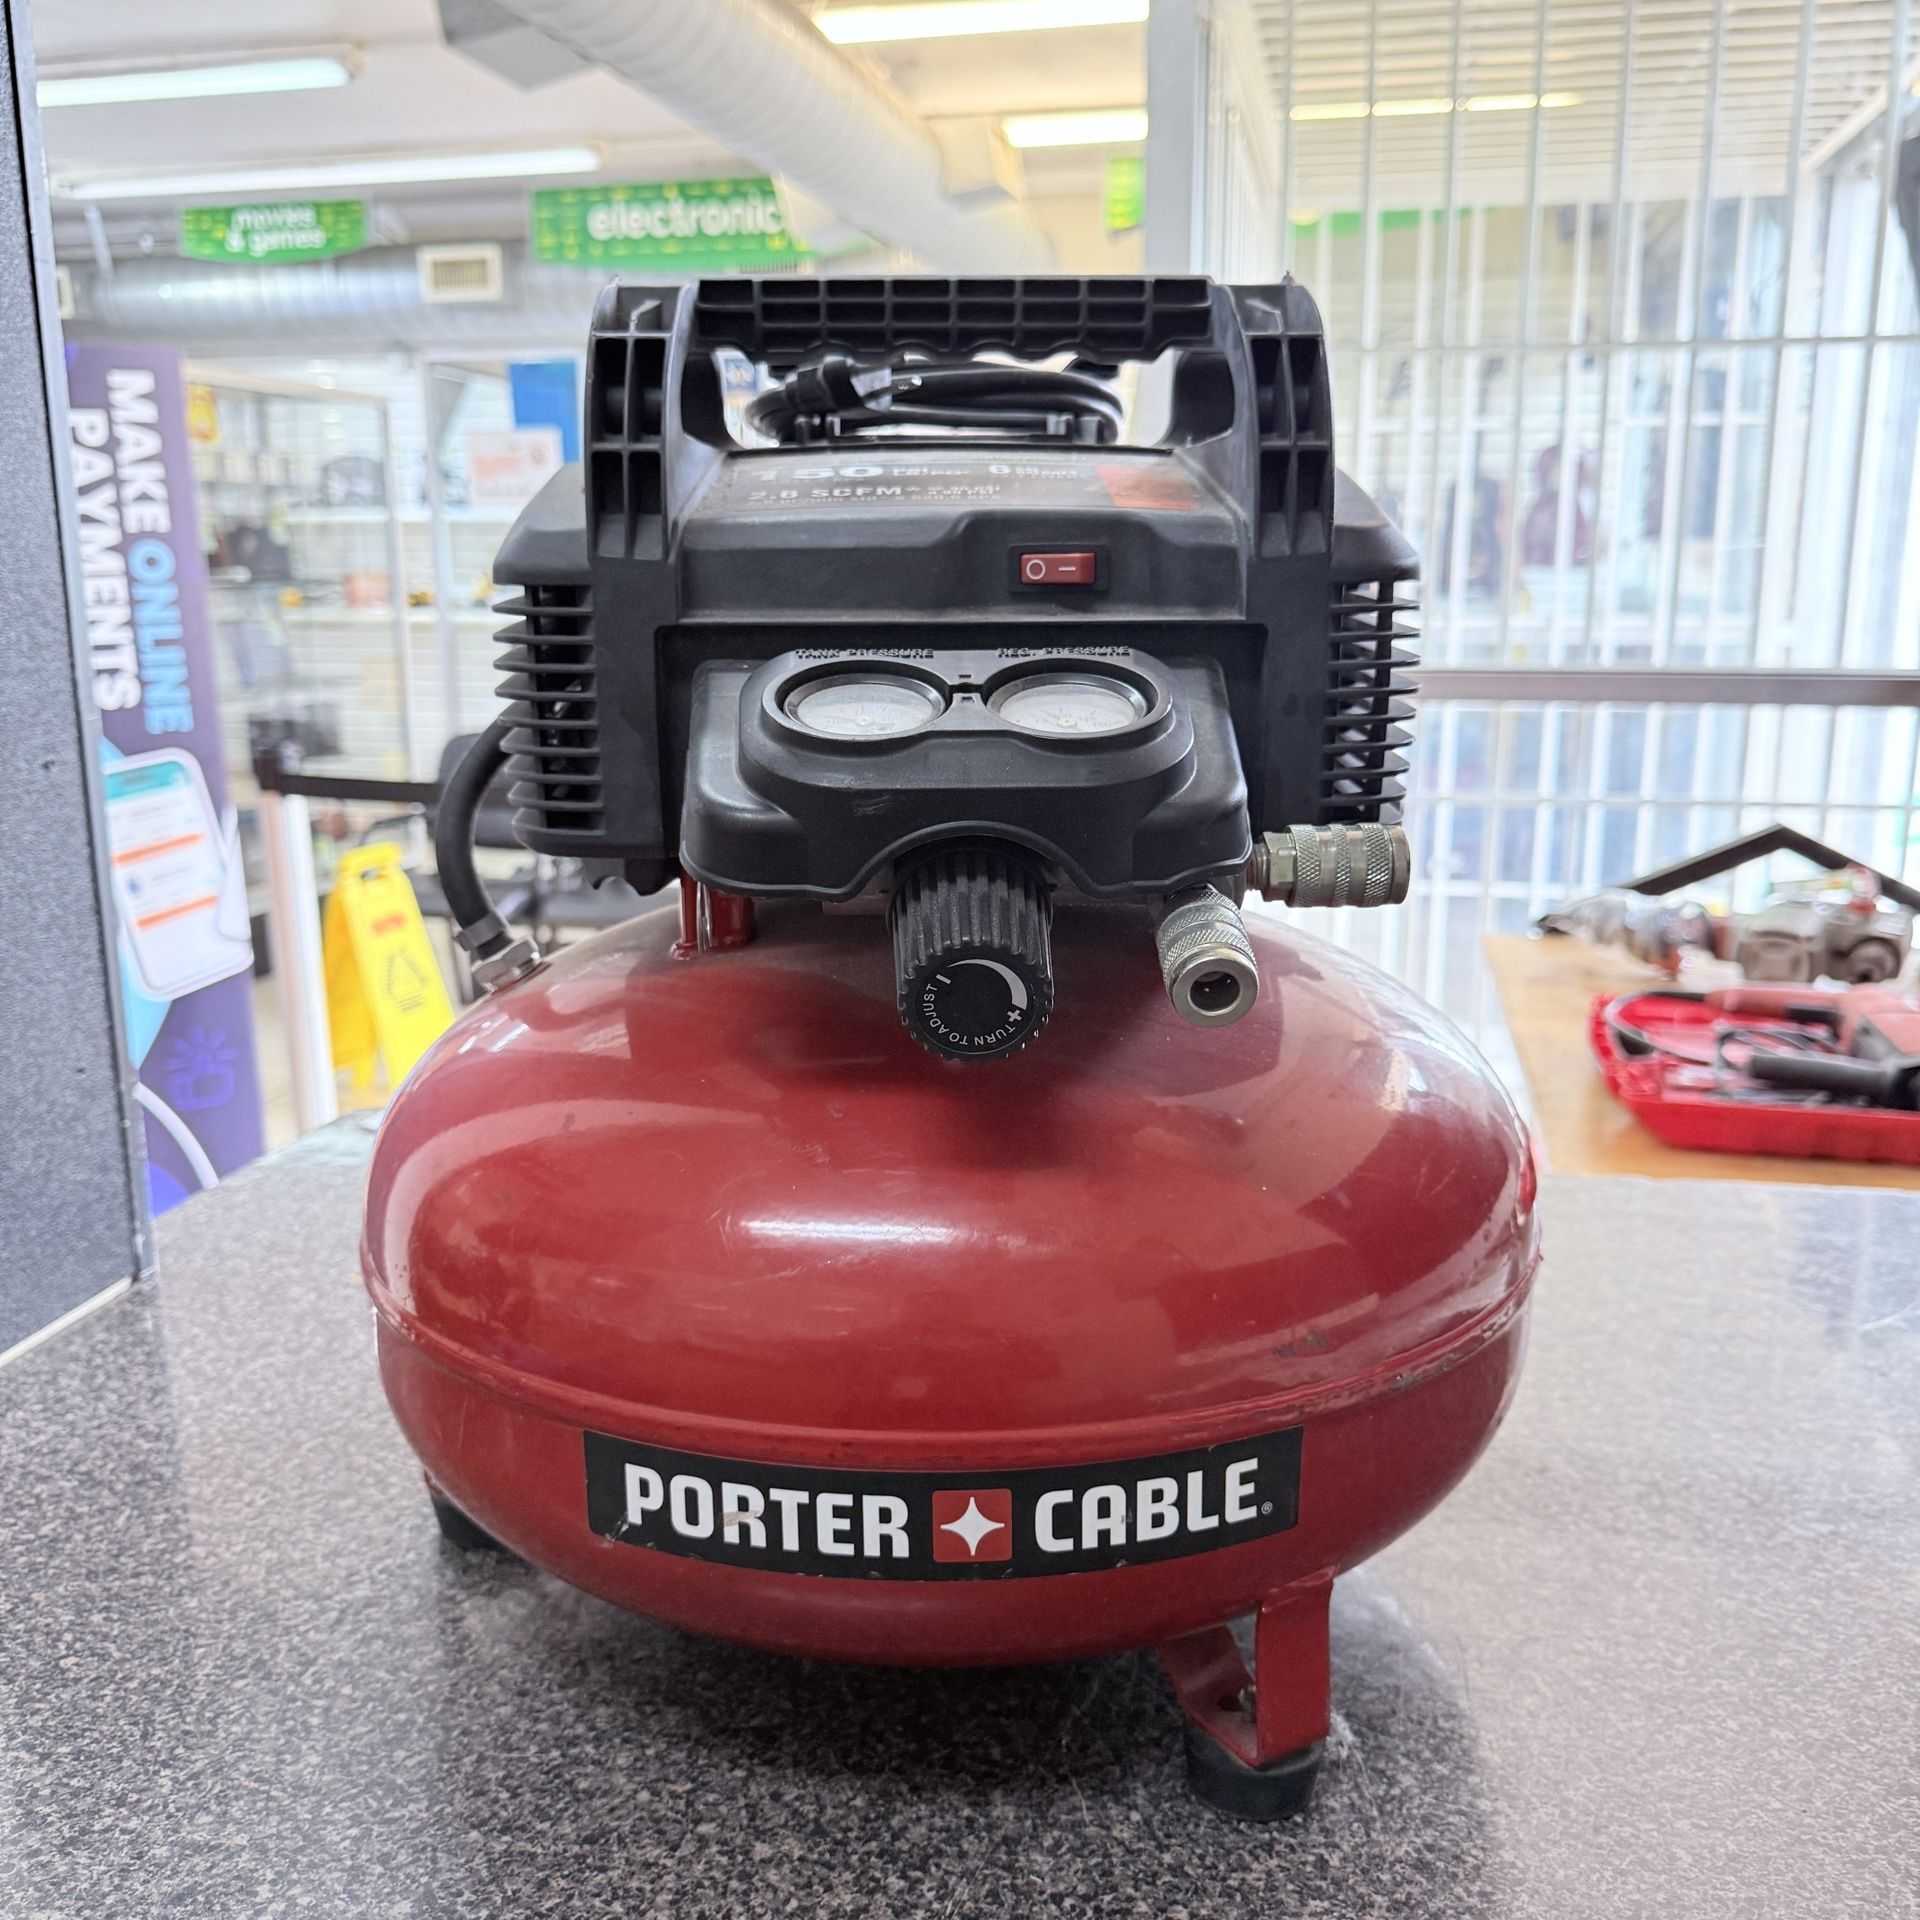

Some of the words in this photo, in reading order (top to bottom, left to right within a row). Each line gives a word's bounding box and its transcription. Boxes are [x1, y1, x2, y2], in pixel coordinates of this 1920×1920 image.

[232, 205, 317, 231] movies
[249, 227, 327, 257] games
[106, 368, 172, 534] MAKE
[752, 466, 884, 481] 150
[749, 490, 798, 500] 2.6
[68, 407, 142, 711] PAYMENTS
[127, 537, 194, 734] ONLINE
[796, 649, 841, 659] TANK
[847, 648, 935, 659] PRESSURE
[997, 648, 1037, 658] REG.
[1041, 646, 1131, 657] PRESSURE
[922, 983, 950, 1034] ADJUST
[948, 1032, 969, 1046] TO
[974, 1024, 1016, 1046] TURN
[624, 1462, 910, 1559] PORTER
